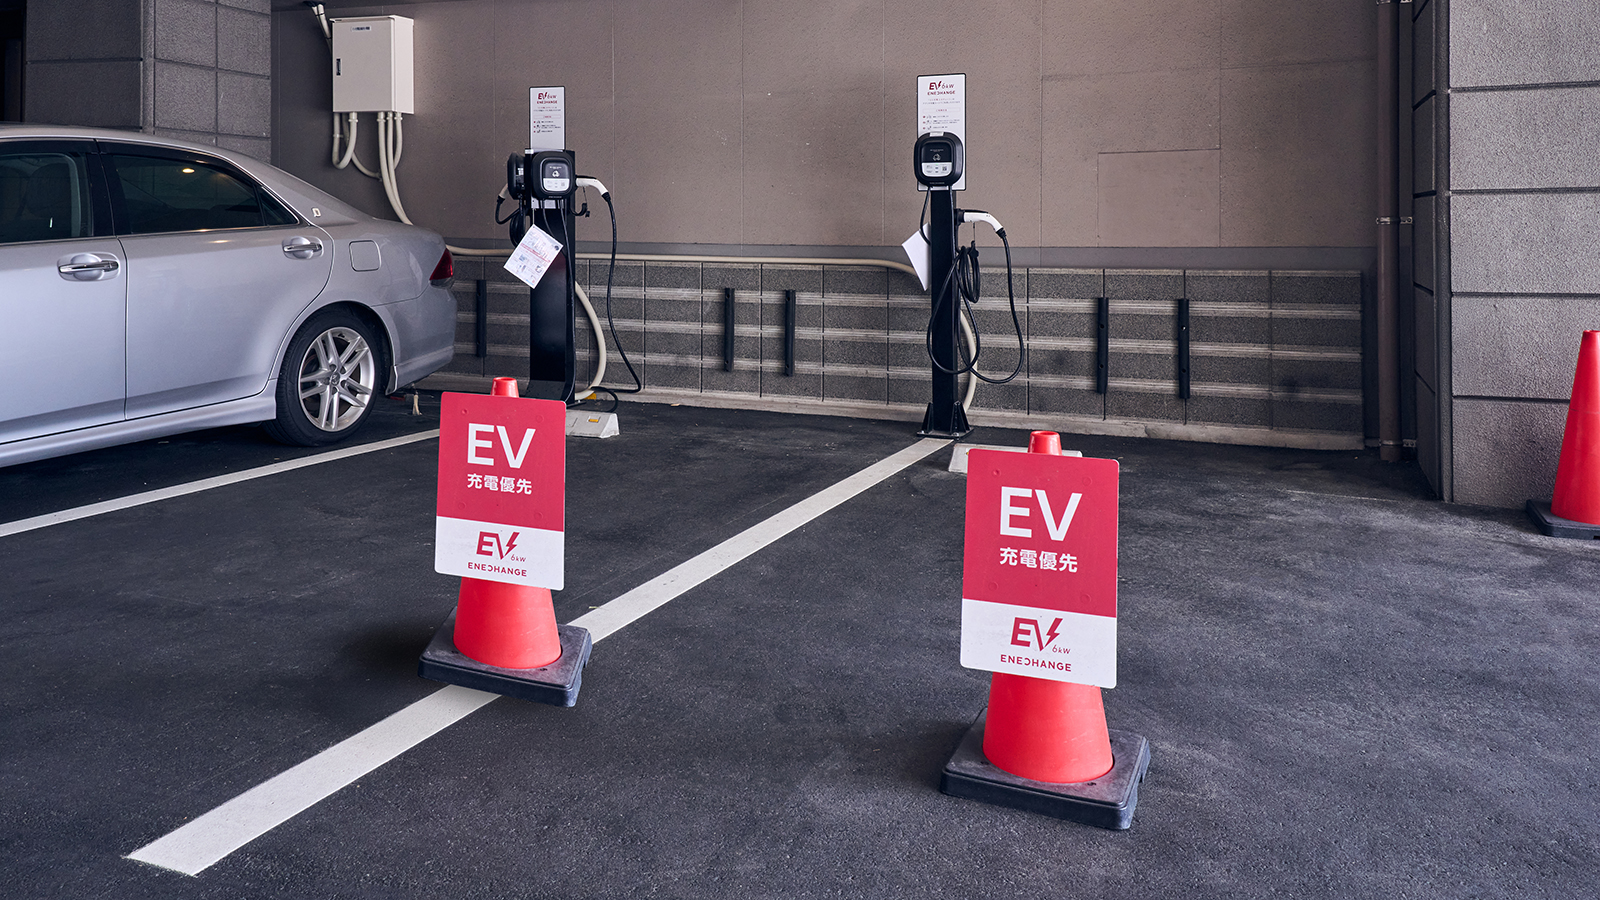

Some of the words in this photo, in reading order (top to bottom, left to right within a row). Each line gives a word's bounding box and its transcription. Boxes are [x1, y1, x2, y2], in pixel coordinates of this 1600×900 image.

[467, 422, 536, 469] EV
[467, 473, 533, 495] 充電優先
[1000, 486, 1083, 542] EV
[476, 531, 520, 560] EV
[510, 554, 527, 563] 6kW
[999, 547, 1078, 573] 充電優先
[1010, 616, 1064, 652] EV
[1051, 644, 1071, 655] 6kW
